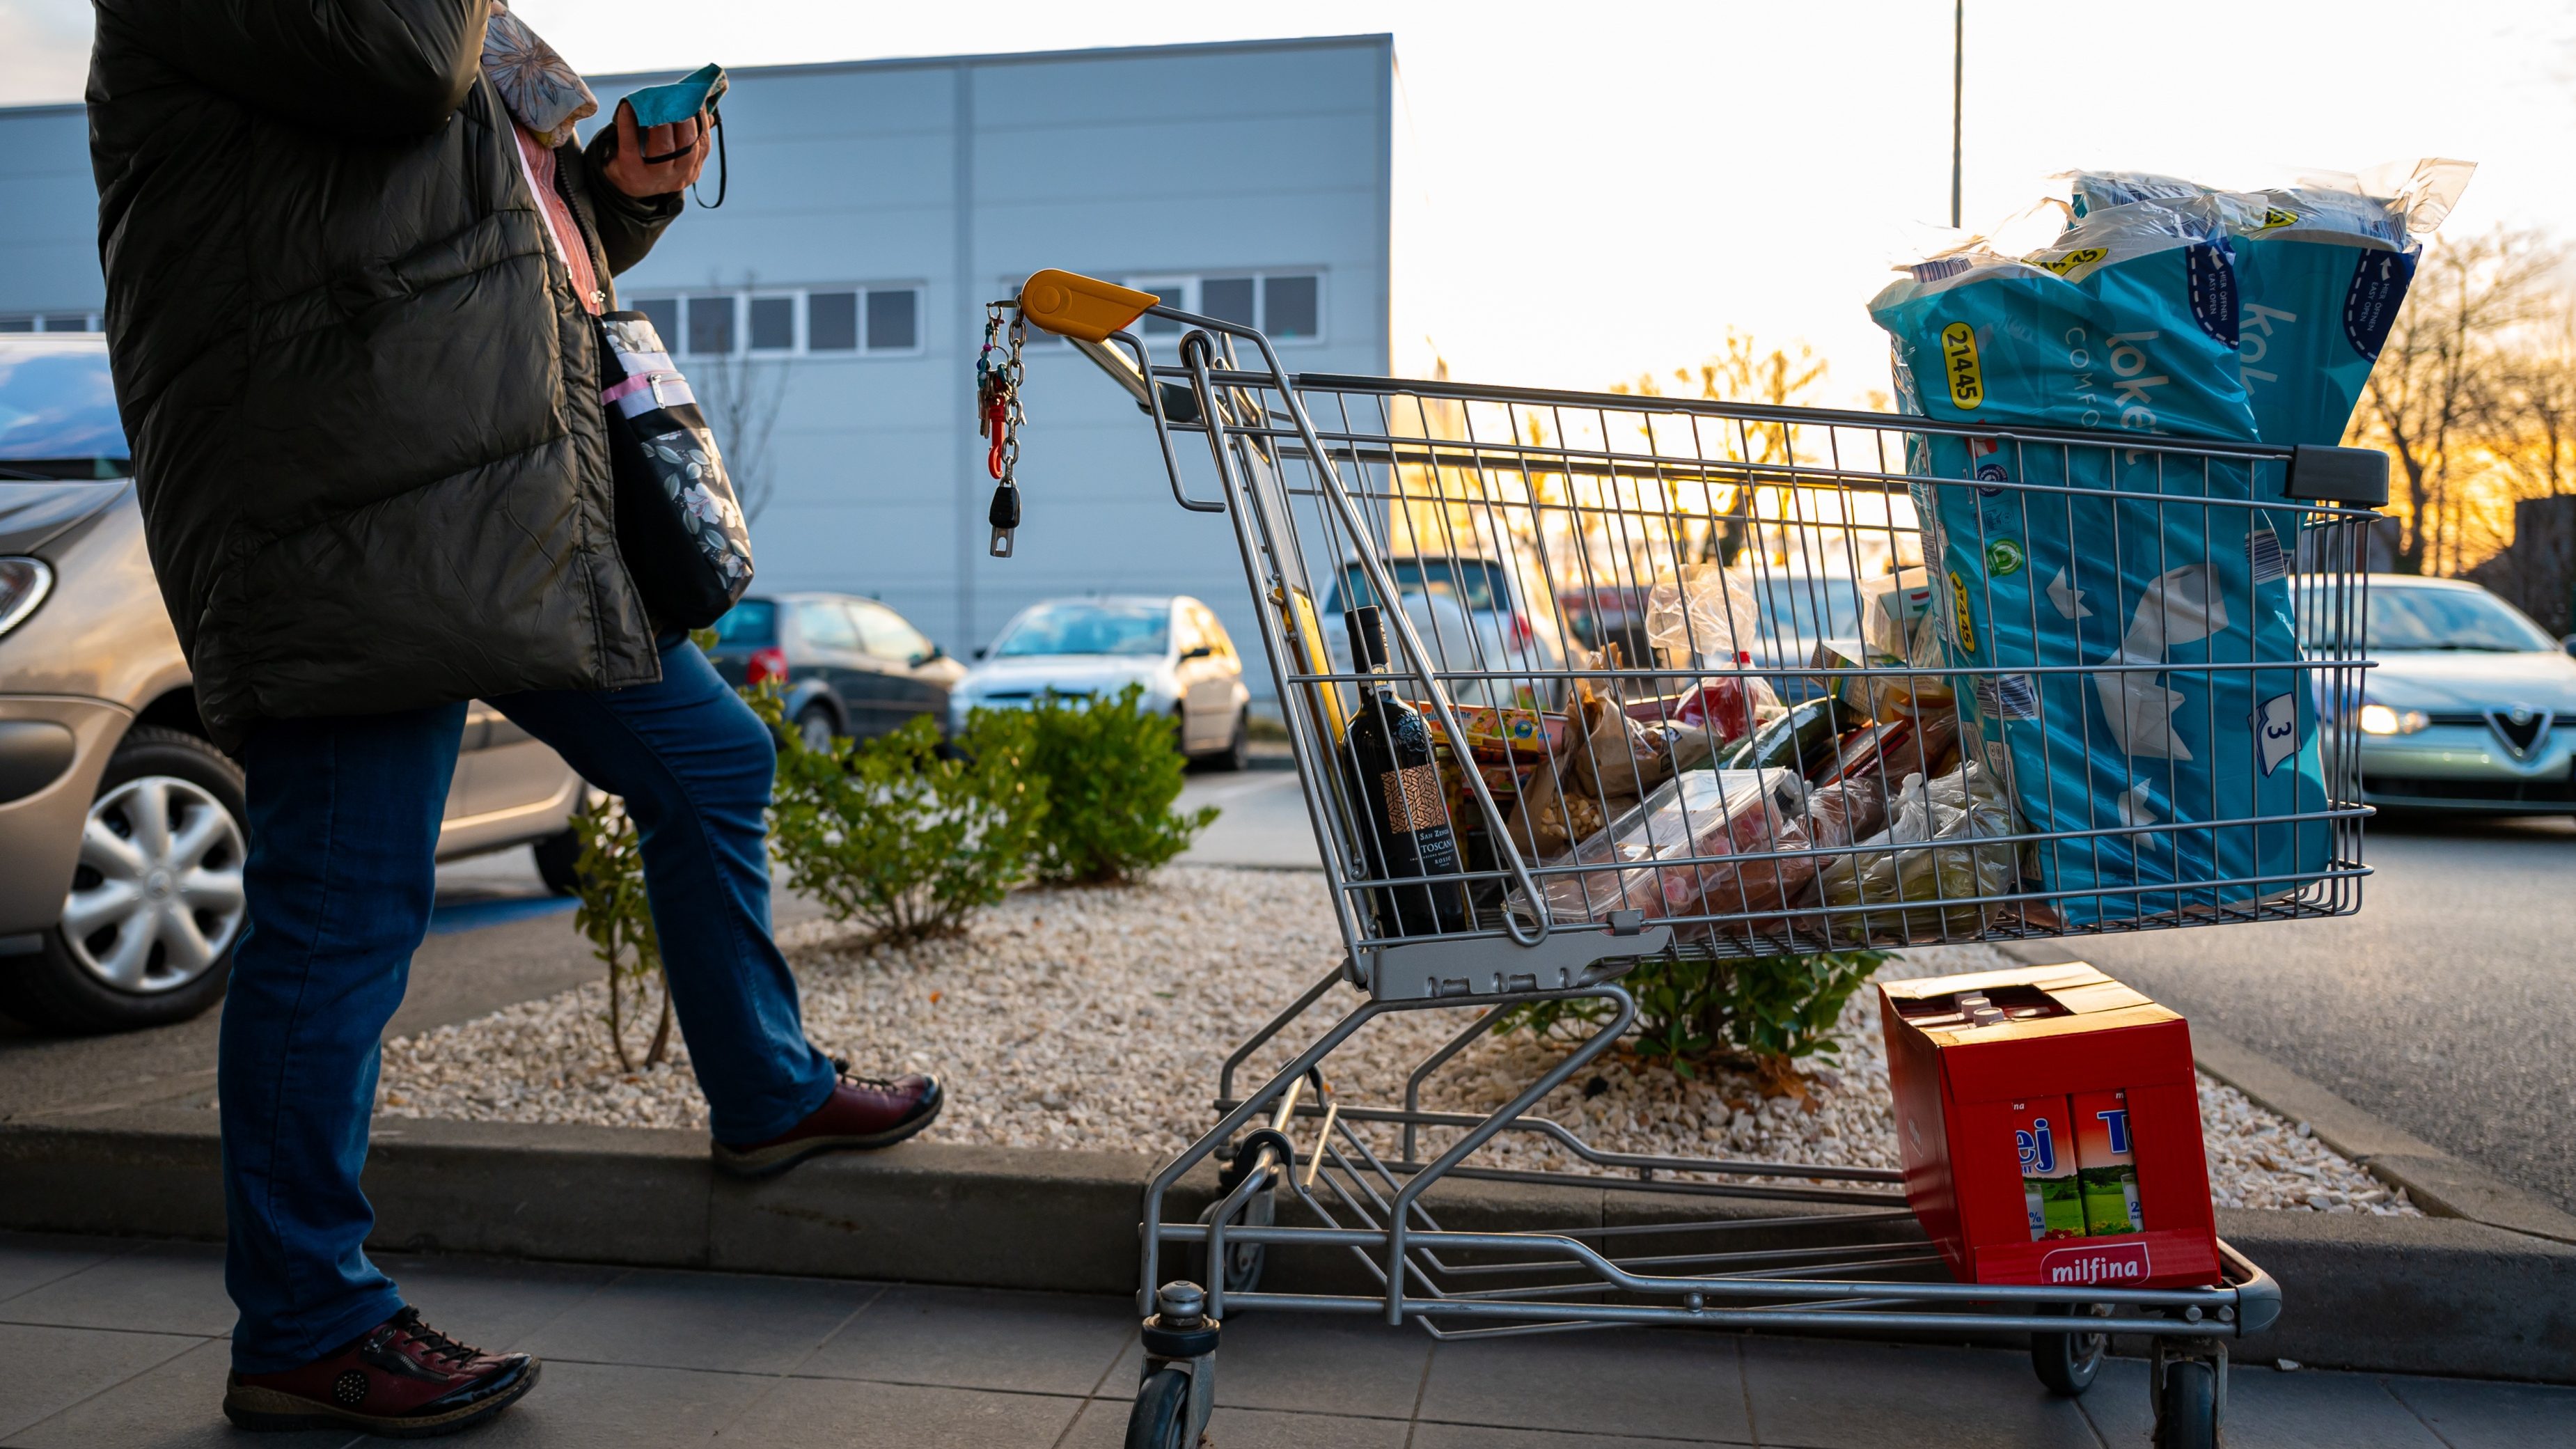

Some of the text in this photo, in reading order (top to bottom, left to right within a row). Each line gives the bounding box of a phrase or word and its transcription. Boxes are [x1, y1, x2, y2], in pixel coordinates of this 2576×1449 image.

[2219, 271, 2228, 321] HIER ÖFFNEN
[2359, 281, 2378, 322] EASY OPEN
[2367, 283, 2390, 331] HIER ÖFFNEN
[1946, 329, 1978, 401] 21445
[2066, 327, 2100, 429] COMFO
[2267, 721, 2292, 739] 3
[1434, 856, 1452, 865] ROSSO
[2012, 1102, 2025, 1111] na
[2096, 1109, 2133, 1154] T
[2052, 1257, 2139, 1285] milfina
